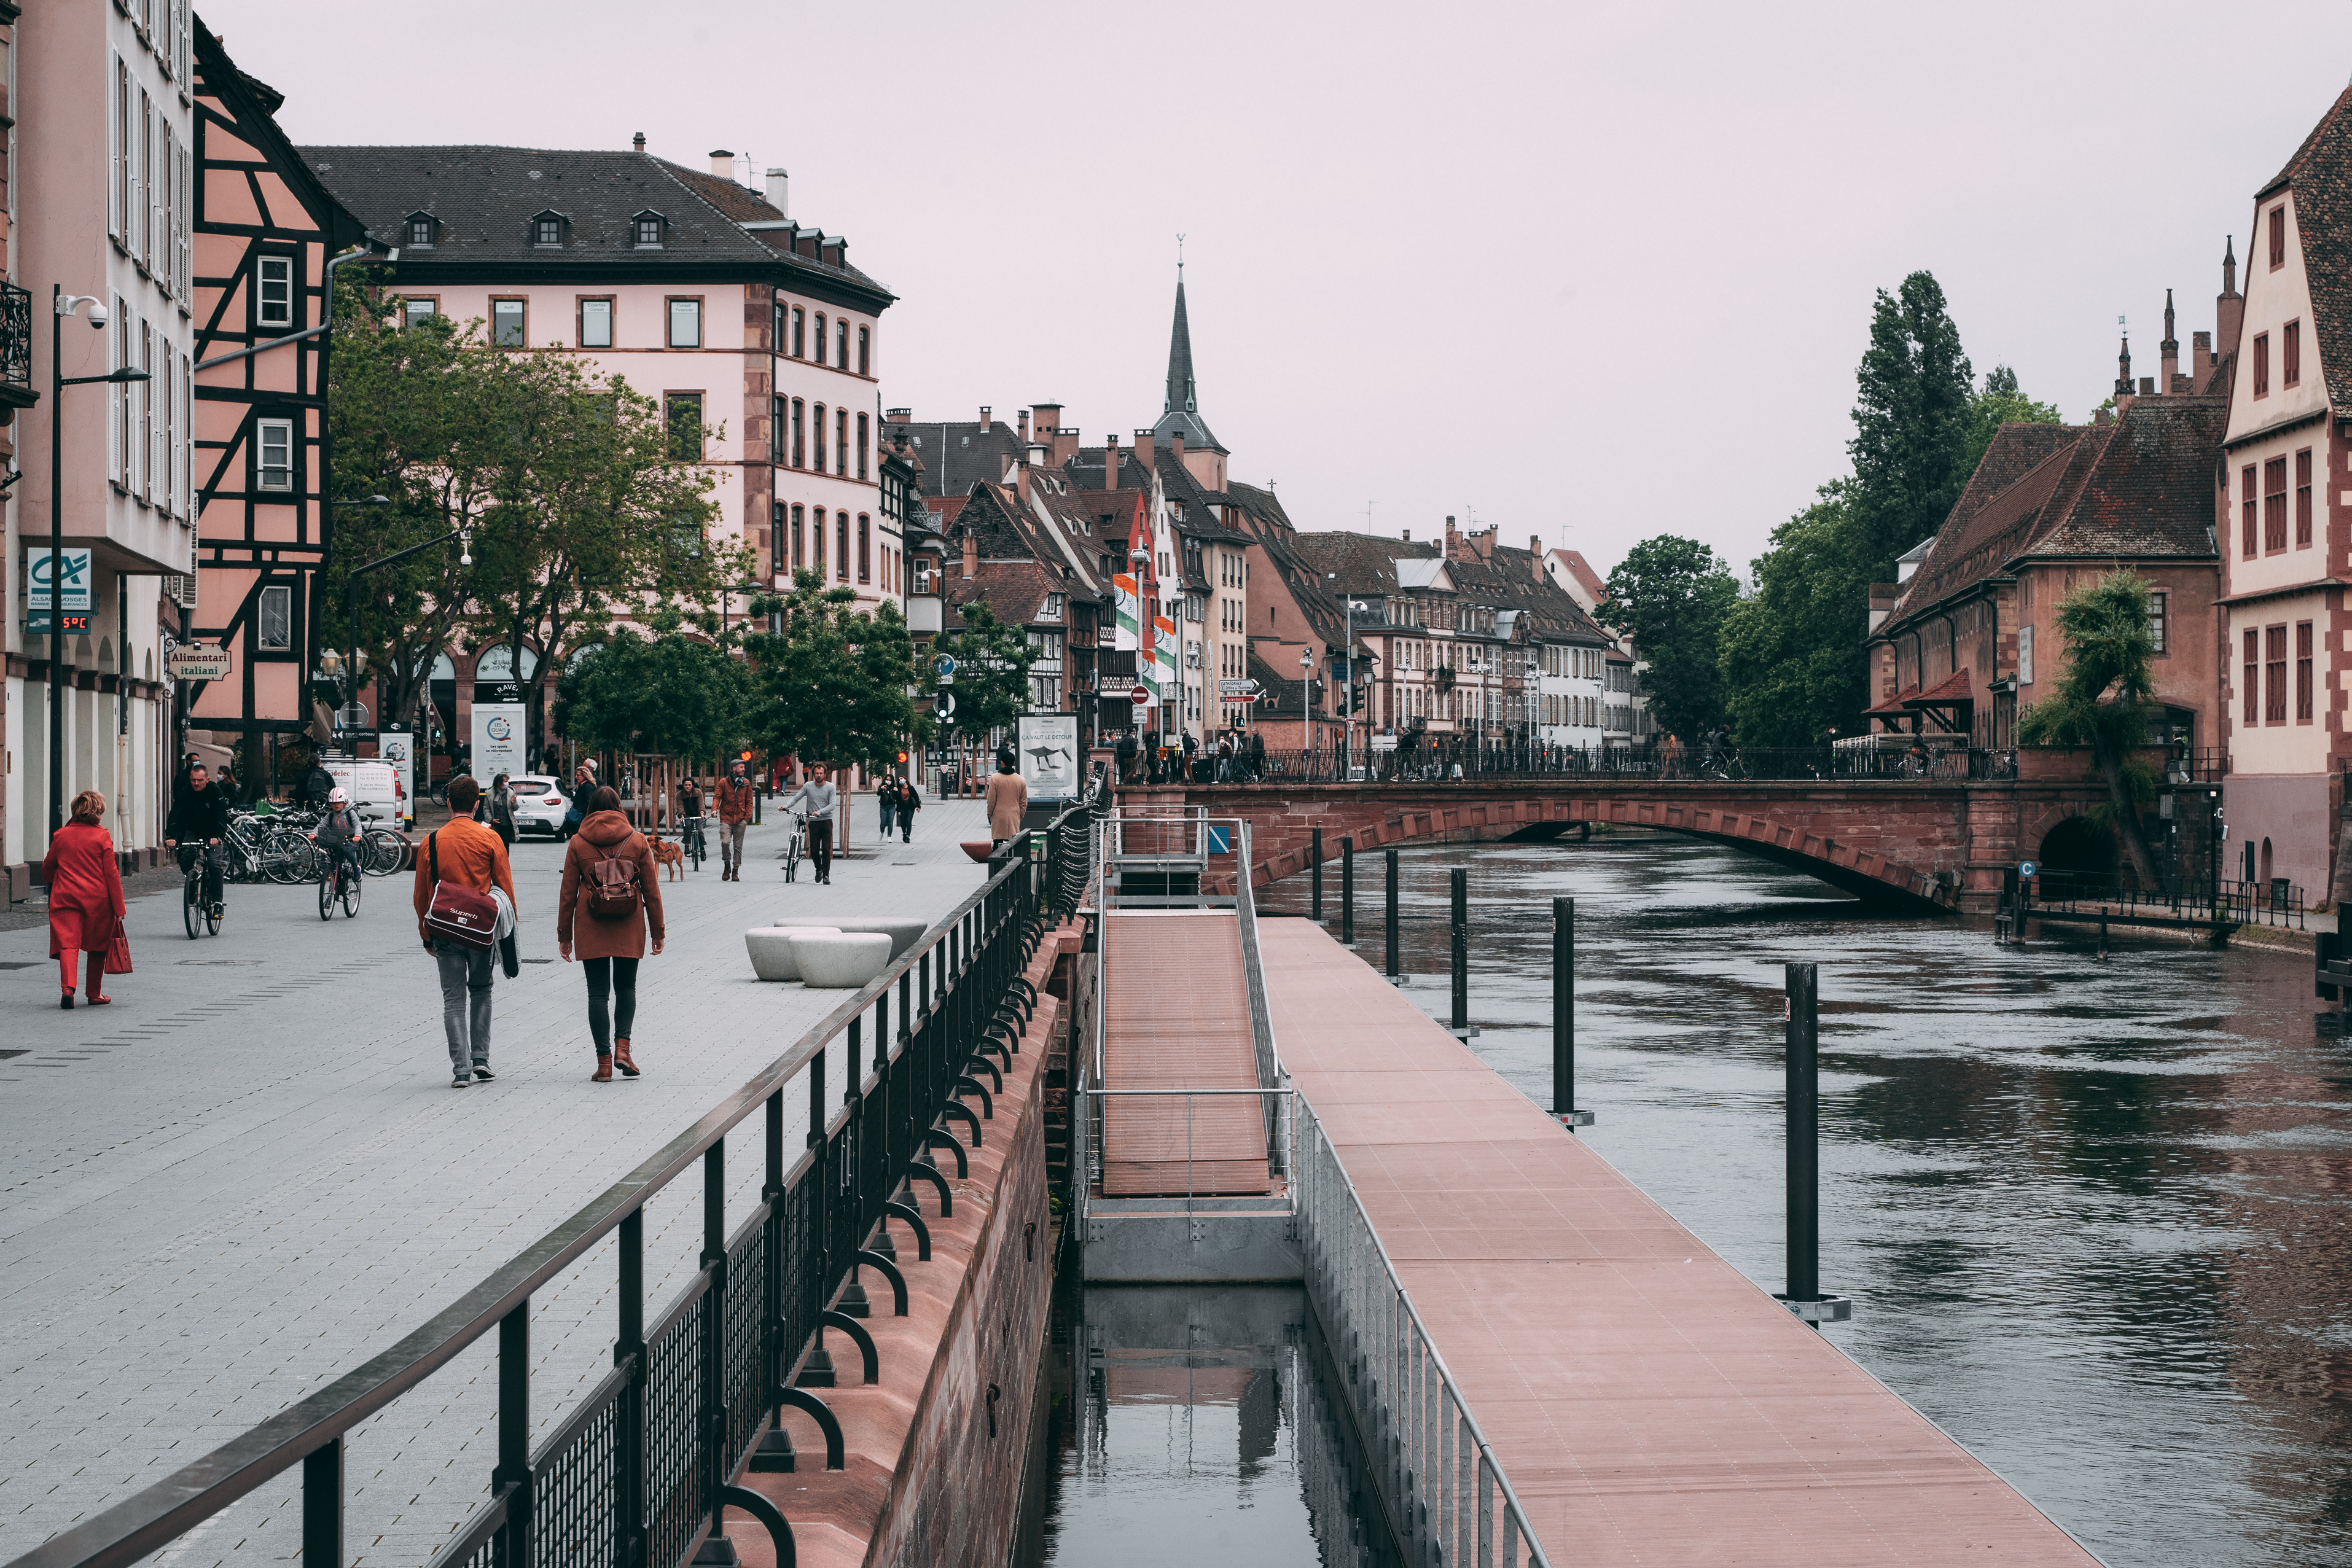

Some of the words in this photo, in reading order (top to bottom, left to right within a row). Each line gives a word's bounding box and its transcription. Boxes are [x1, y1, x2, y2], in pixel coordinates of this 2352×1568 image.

[171, 653, 227, 662] Alimentari
[181, 666, 218, 675] italiani
[2022, 863, 2032, 875] C
[450, 908, 478, 919] Superb
